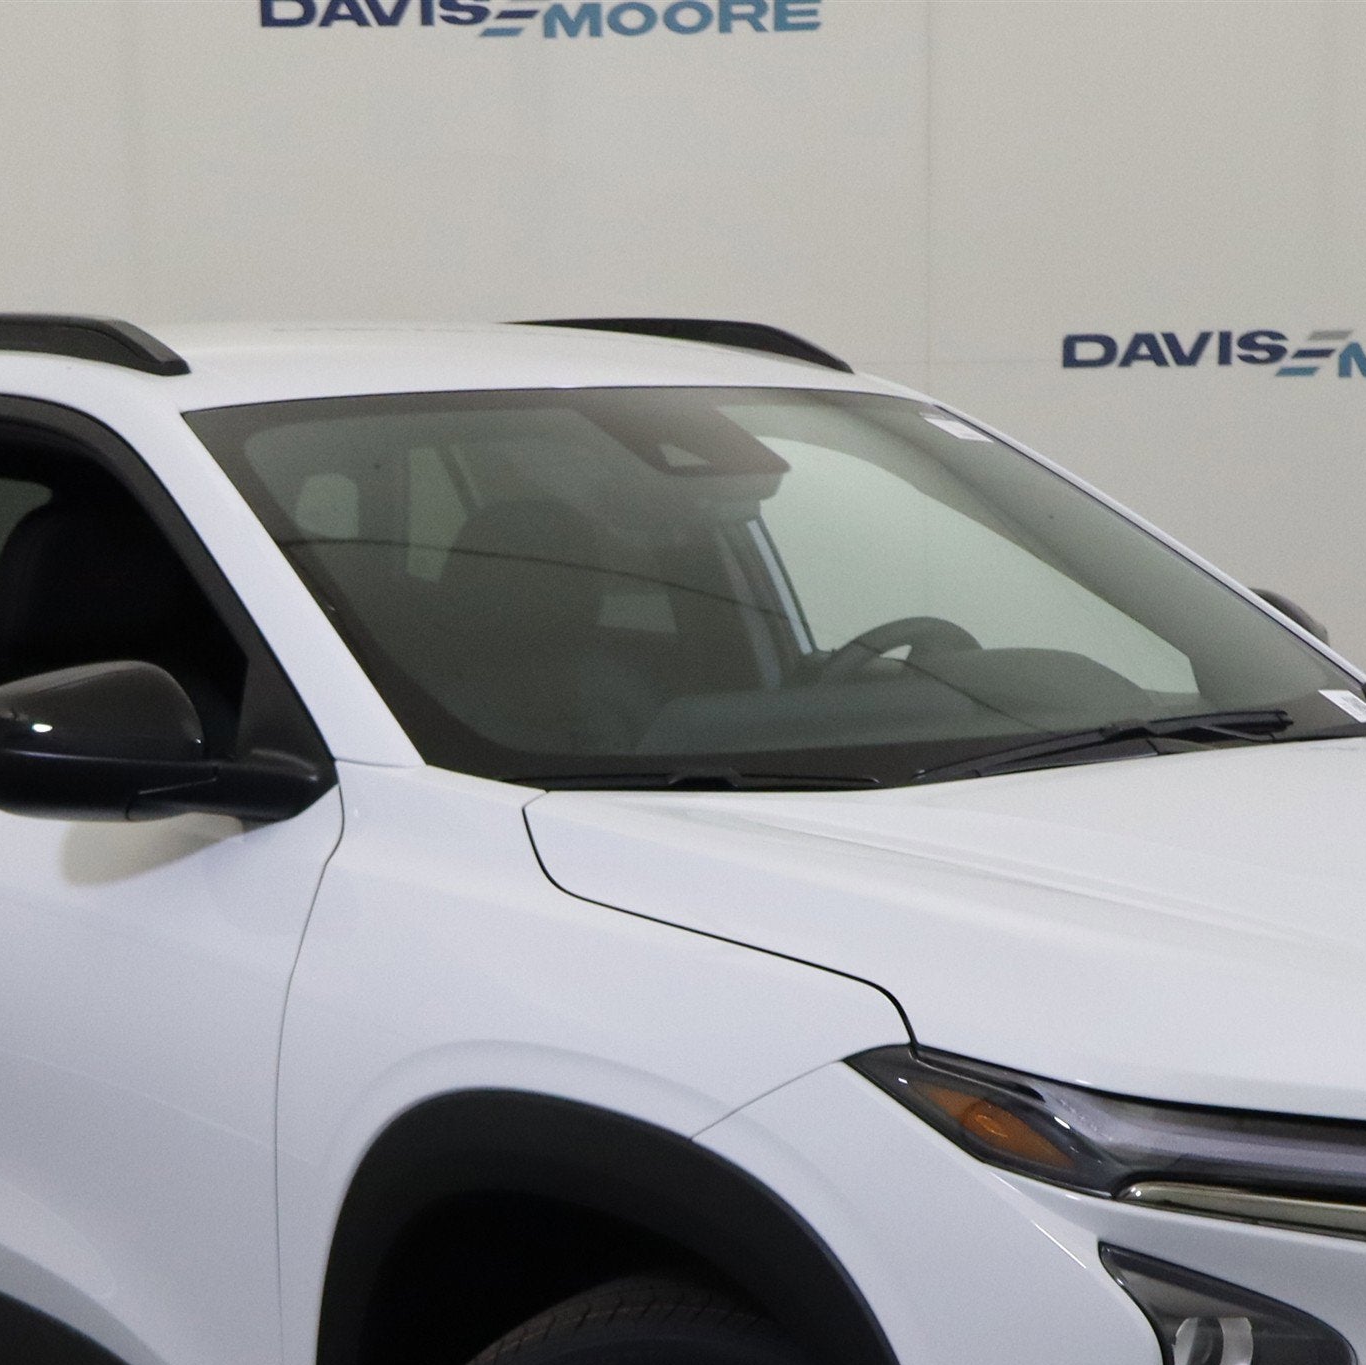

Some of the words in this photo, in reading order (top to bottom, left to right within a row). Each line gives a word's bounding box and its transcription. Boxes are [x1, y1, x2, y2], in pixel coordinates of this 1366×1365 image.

[259, 0, 491, 28] DAVIS
[543, 1, 822, 38] MOORE
[1062, 329, 1288, 369] DAVIS
